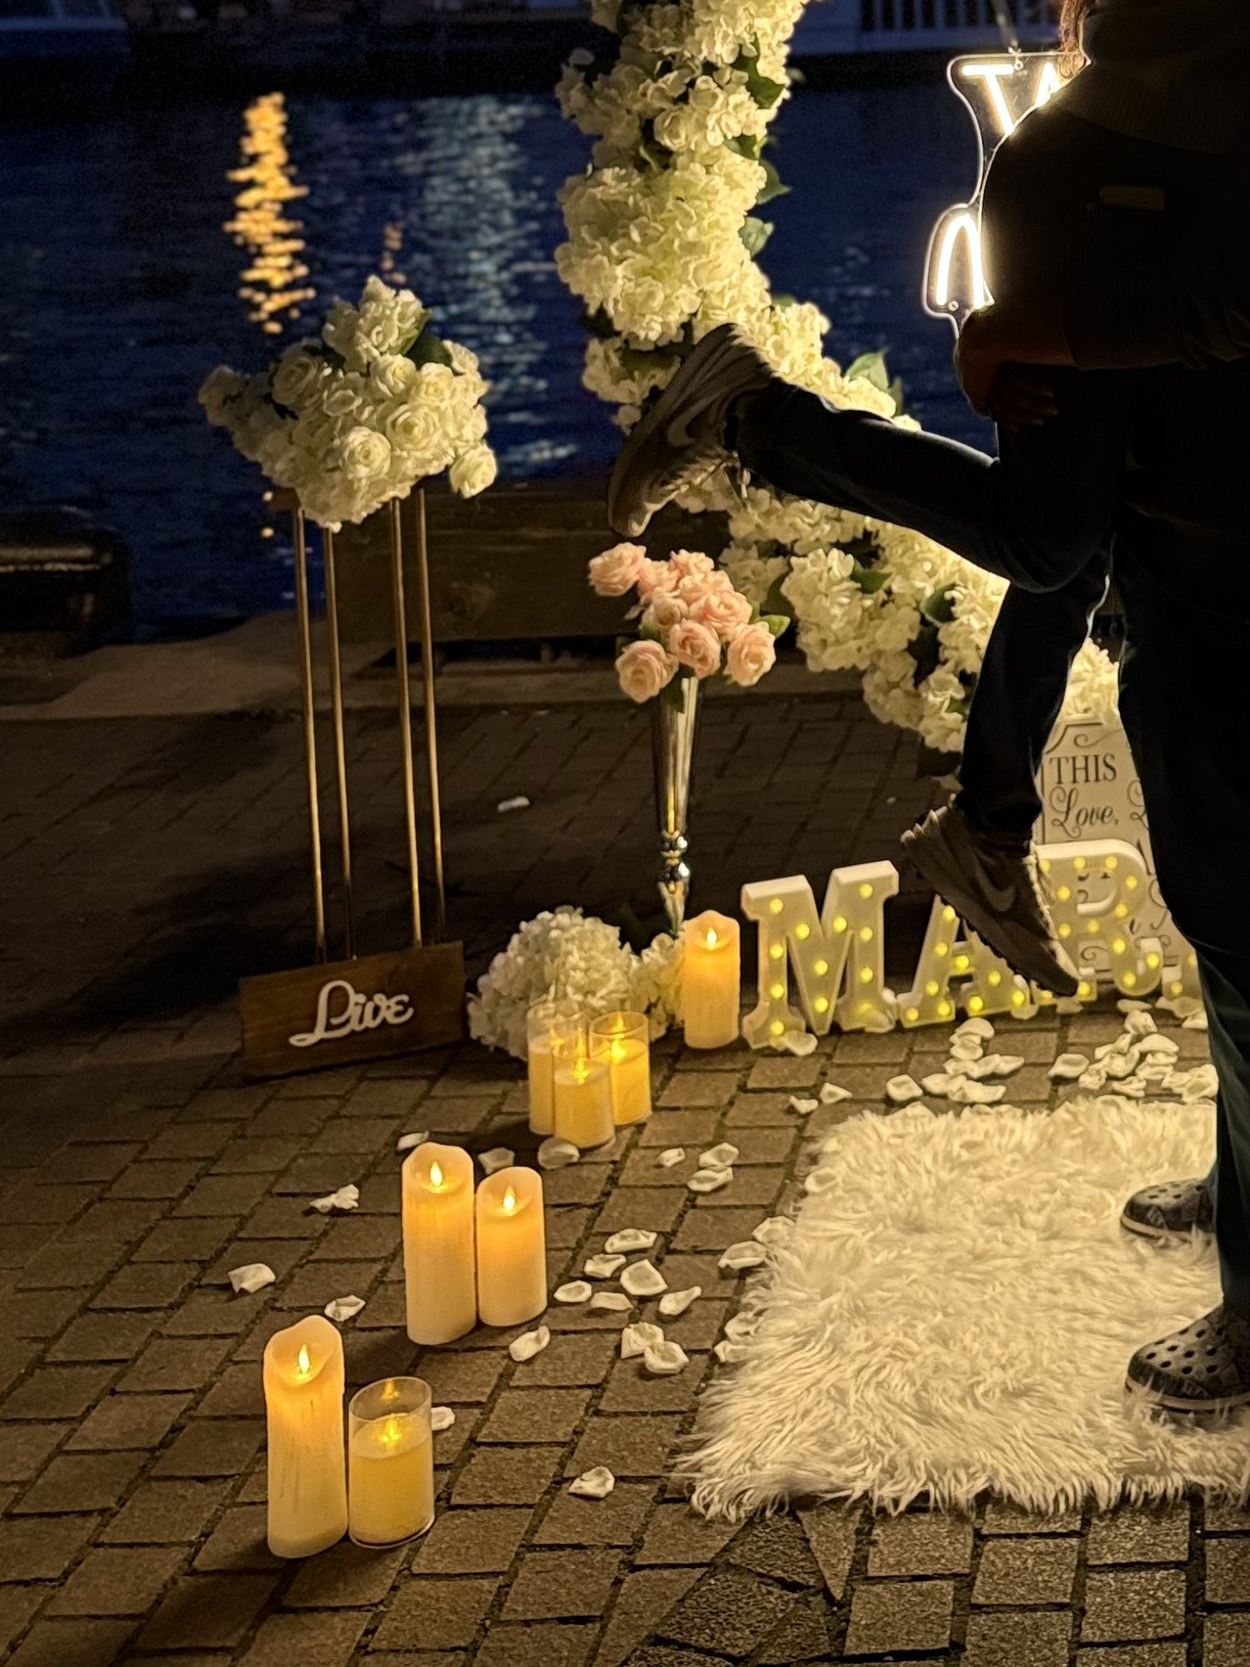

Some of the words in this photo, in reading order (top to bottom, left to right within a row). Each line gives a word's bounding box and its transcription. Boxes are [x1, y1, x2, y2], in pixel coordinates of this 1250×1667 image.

[1048, 752, 1118, 786] THIS
[1048, 784, 1120, 839] Love,
[288, 979, 415, 1048] Live
